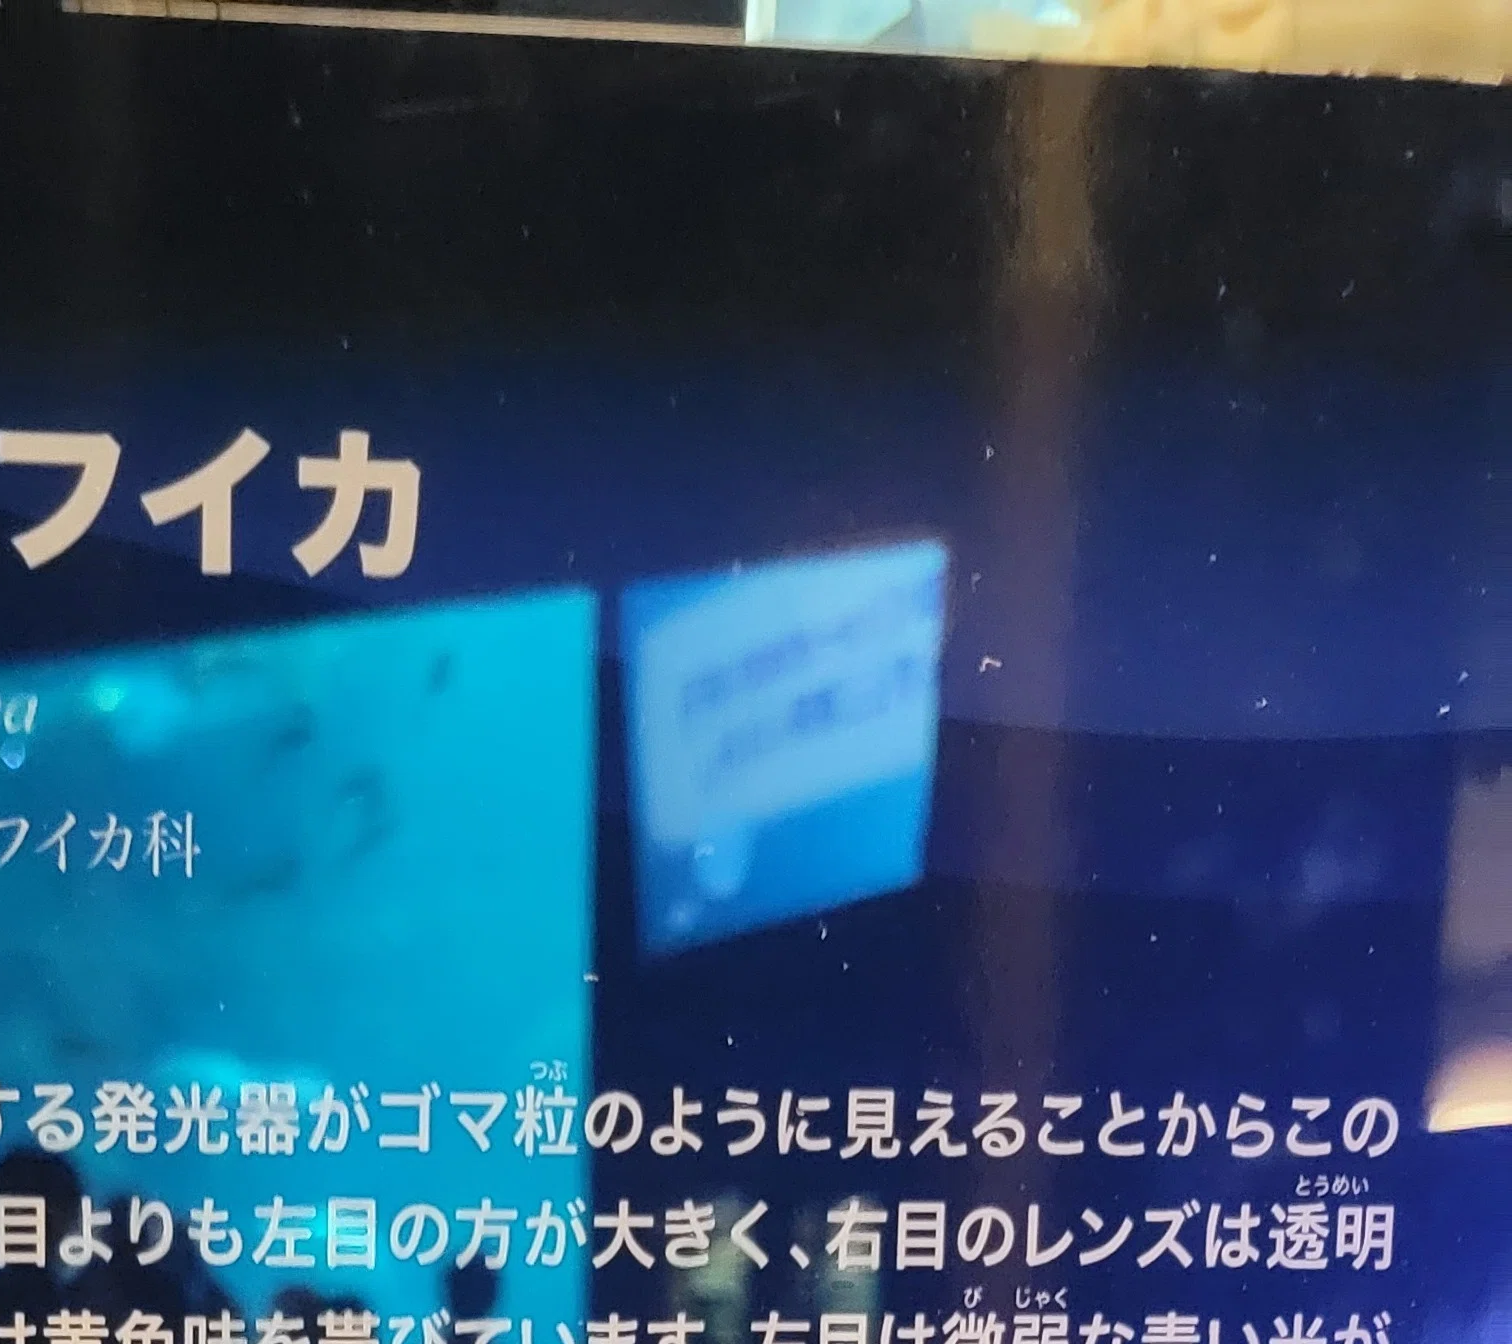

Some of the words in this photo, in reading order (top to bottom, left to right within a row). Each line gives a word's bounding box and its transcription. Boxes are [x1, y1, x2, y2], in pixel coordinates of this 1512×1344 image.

[529, 1059, 568, 1081] つぶ
[1295, 1174, 1368, 1197] とうめい
[963, 1286, 983, 1309] び
[1015, 1286, 1068, 1310] じゃく
